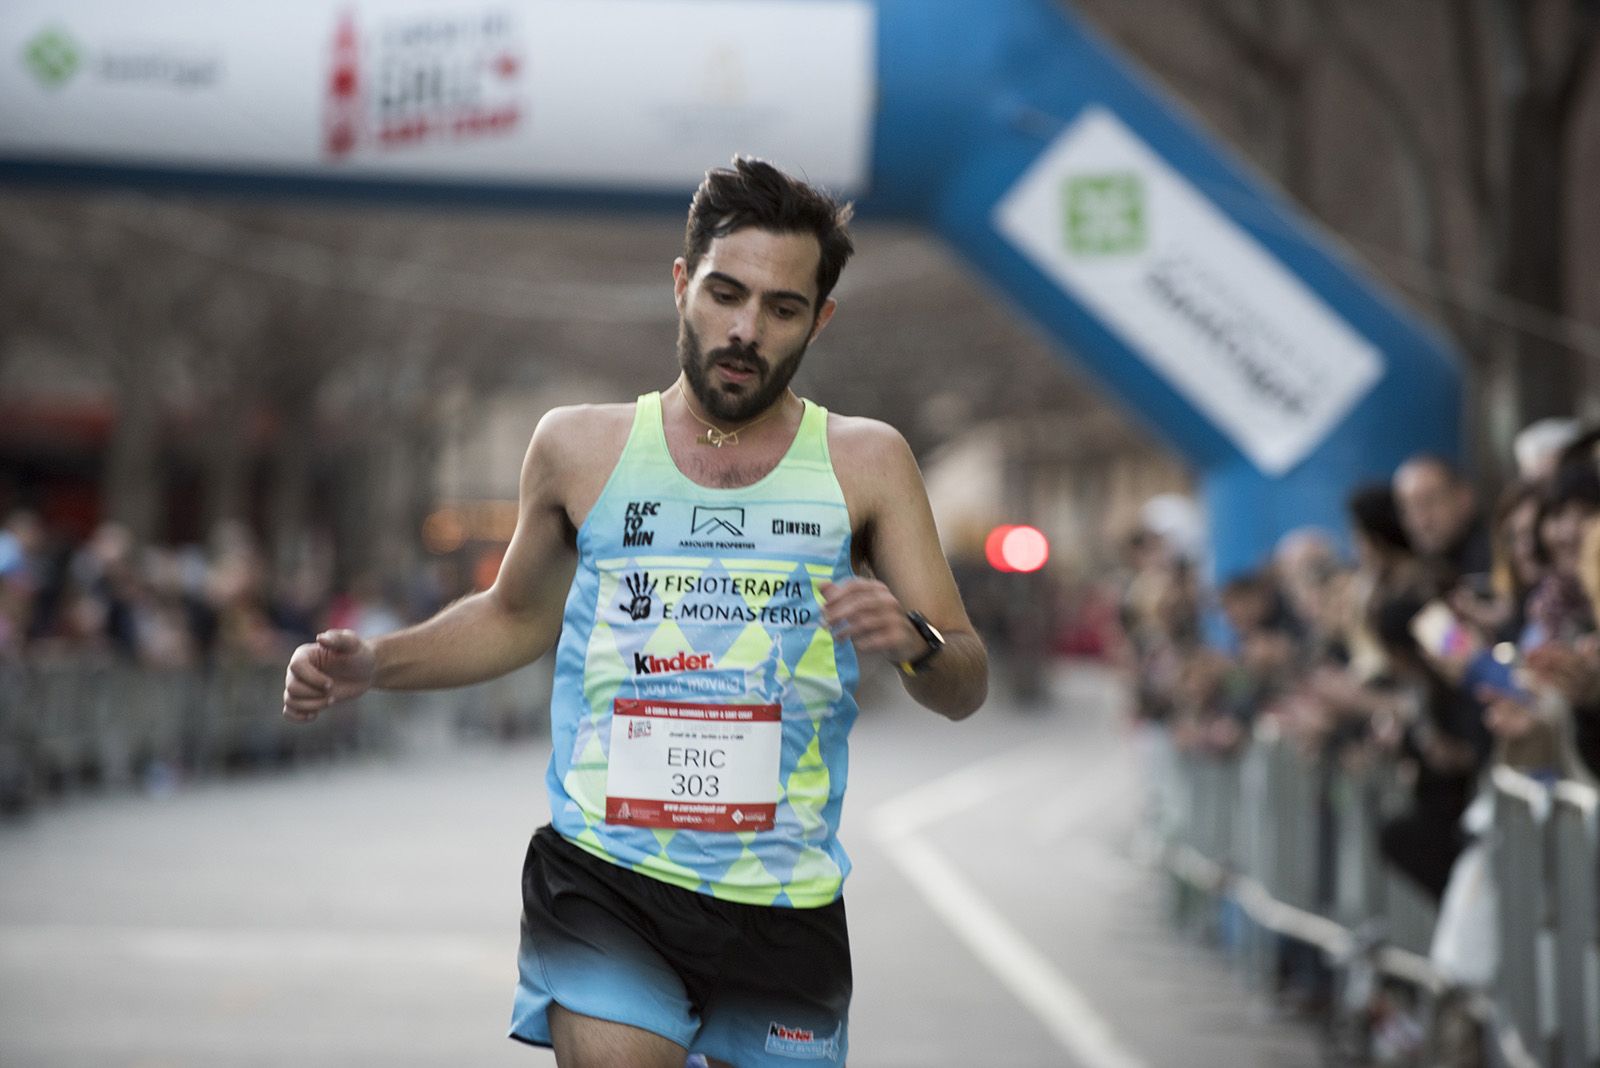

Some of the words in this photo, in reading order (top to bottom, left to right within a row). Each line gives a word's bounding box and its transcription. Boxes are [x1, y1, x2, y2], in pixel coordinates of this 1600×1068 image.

[624, 501, 661, 516] FLEC
[624, 516, 644, 531] TO
[623, 530, 655, 548] MIN
[679, 540, 714, 549] ABSOLUTE
[715, 541, 756, 550] PROPERTIES
[664, 575, 803, 598] FISIOTERAPIA
[667, 747, 727, 769] ERIC
[671, 773, 720, 798] 303
